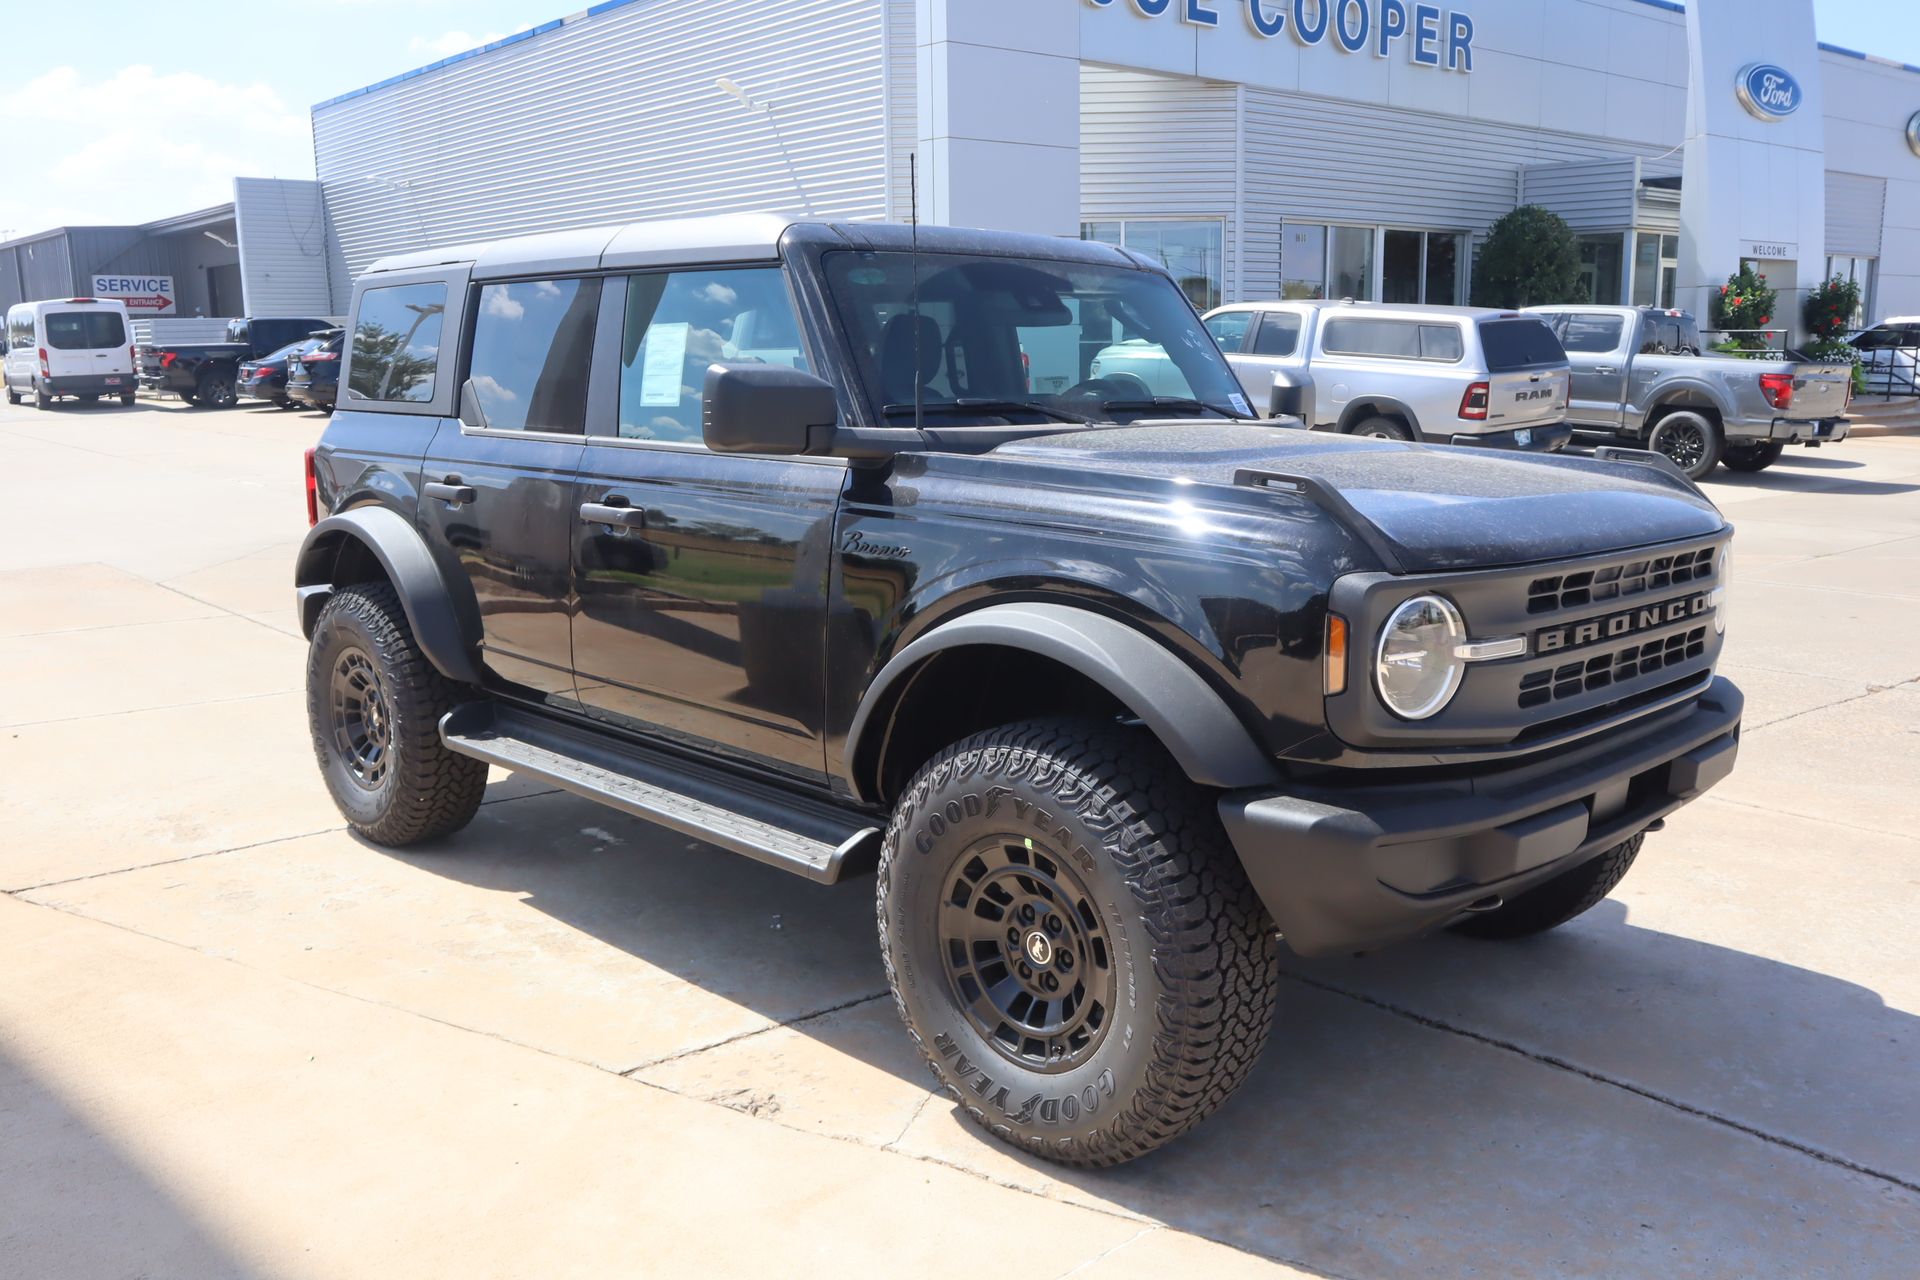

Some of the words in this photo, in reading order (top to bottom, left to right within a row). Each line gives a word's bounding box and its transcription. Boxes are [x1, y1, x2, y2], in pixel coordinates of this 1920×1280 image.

[1247, 0, 1474, 72] COOPER
[1760, 73, 1793, 108] Ford
[1752, 245, 1787, 257] WELCOME
[96, 278, 170, 292] SERVICE
[129, 297, 164, 306] ENTRANCE
[1515, 388, 1552, 402] RAM
[842, 530, 912, 558] Bronco
[1538, 595, 1710, 652] BRONCO
[915, 785, 1098, 876] GOODYEAR
[933, 1030, 1117, 1128] GOODYEAR
